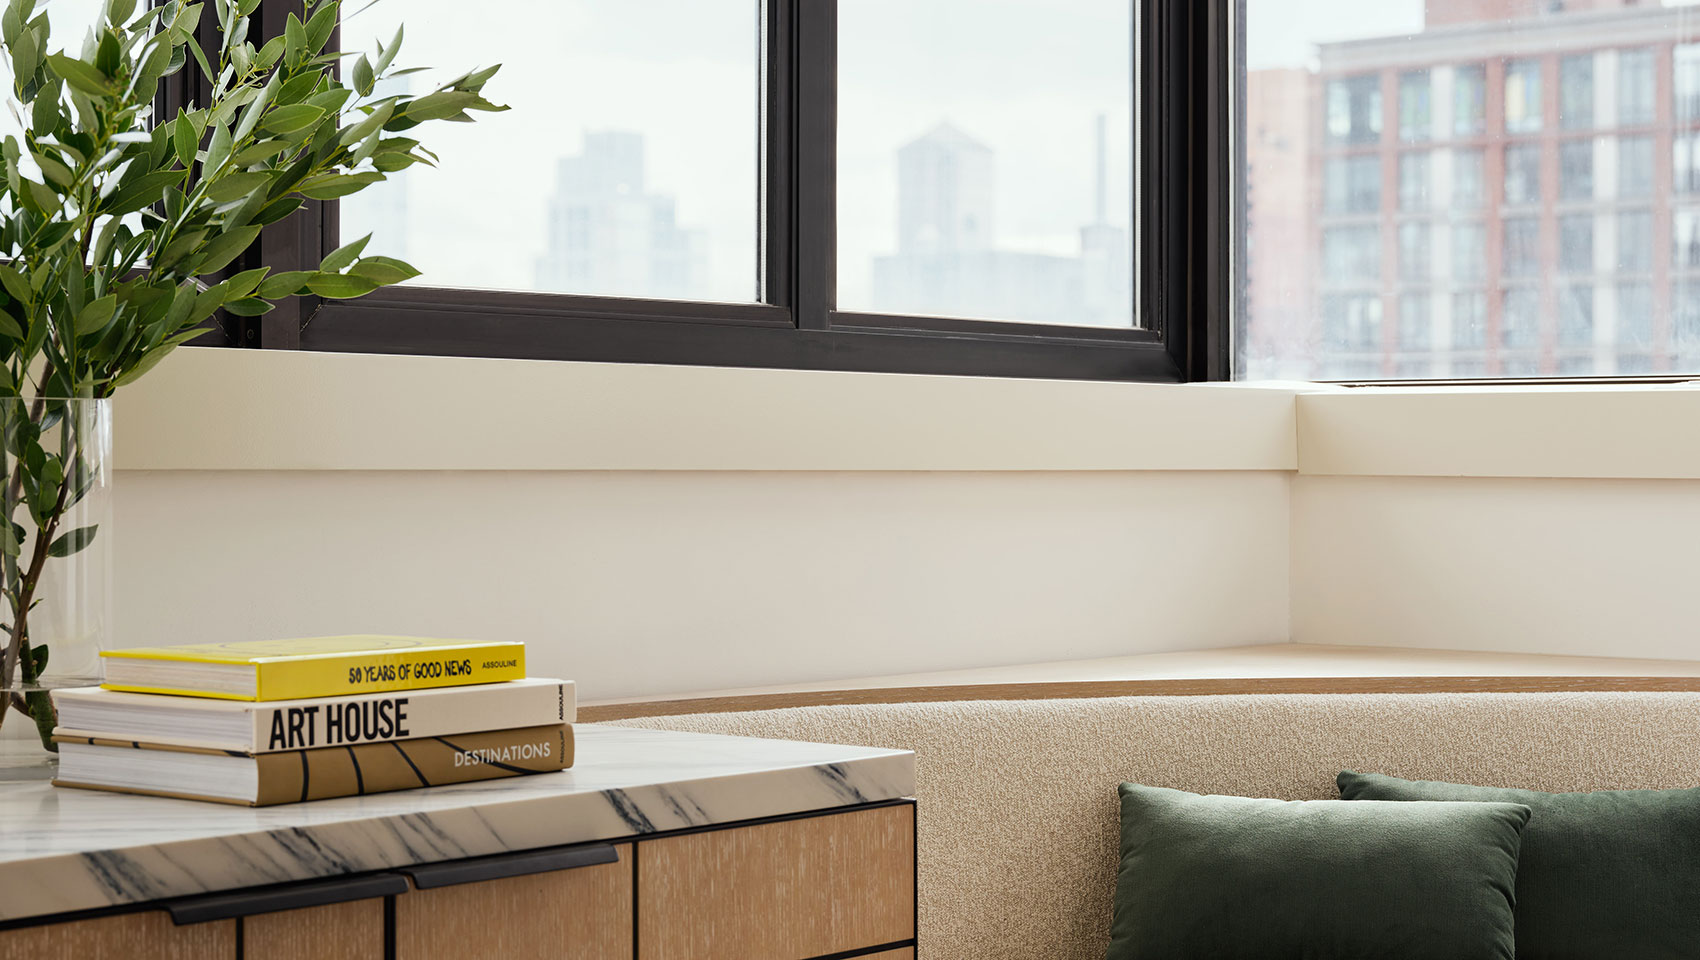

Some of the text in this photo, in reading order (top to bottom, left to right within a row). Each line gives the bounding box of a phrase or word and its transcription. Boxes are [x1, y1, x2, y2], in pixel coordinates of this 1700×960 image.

[349, 659, 472, 684] 50 YEARS OF GOOD NEWS
[482, 659, 517, 669] ASSOULINE
[268, 698, 410, 750] ART HOUSE
[454, 742, 551, 767] DESTINATIONS
